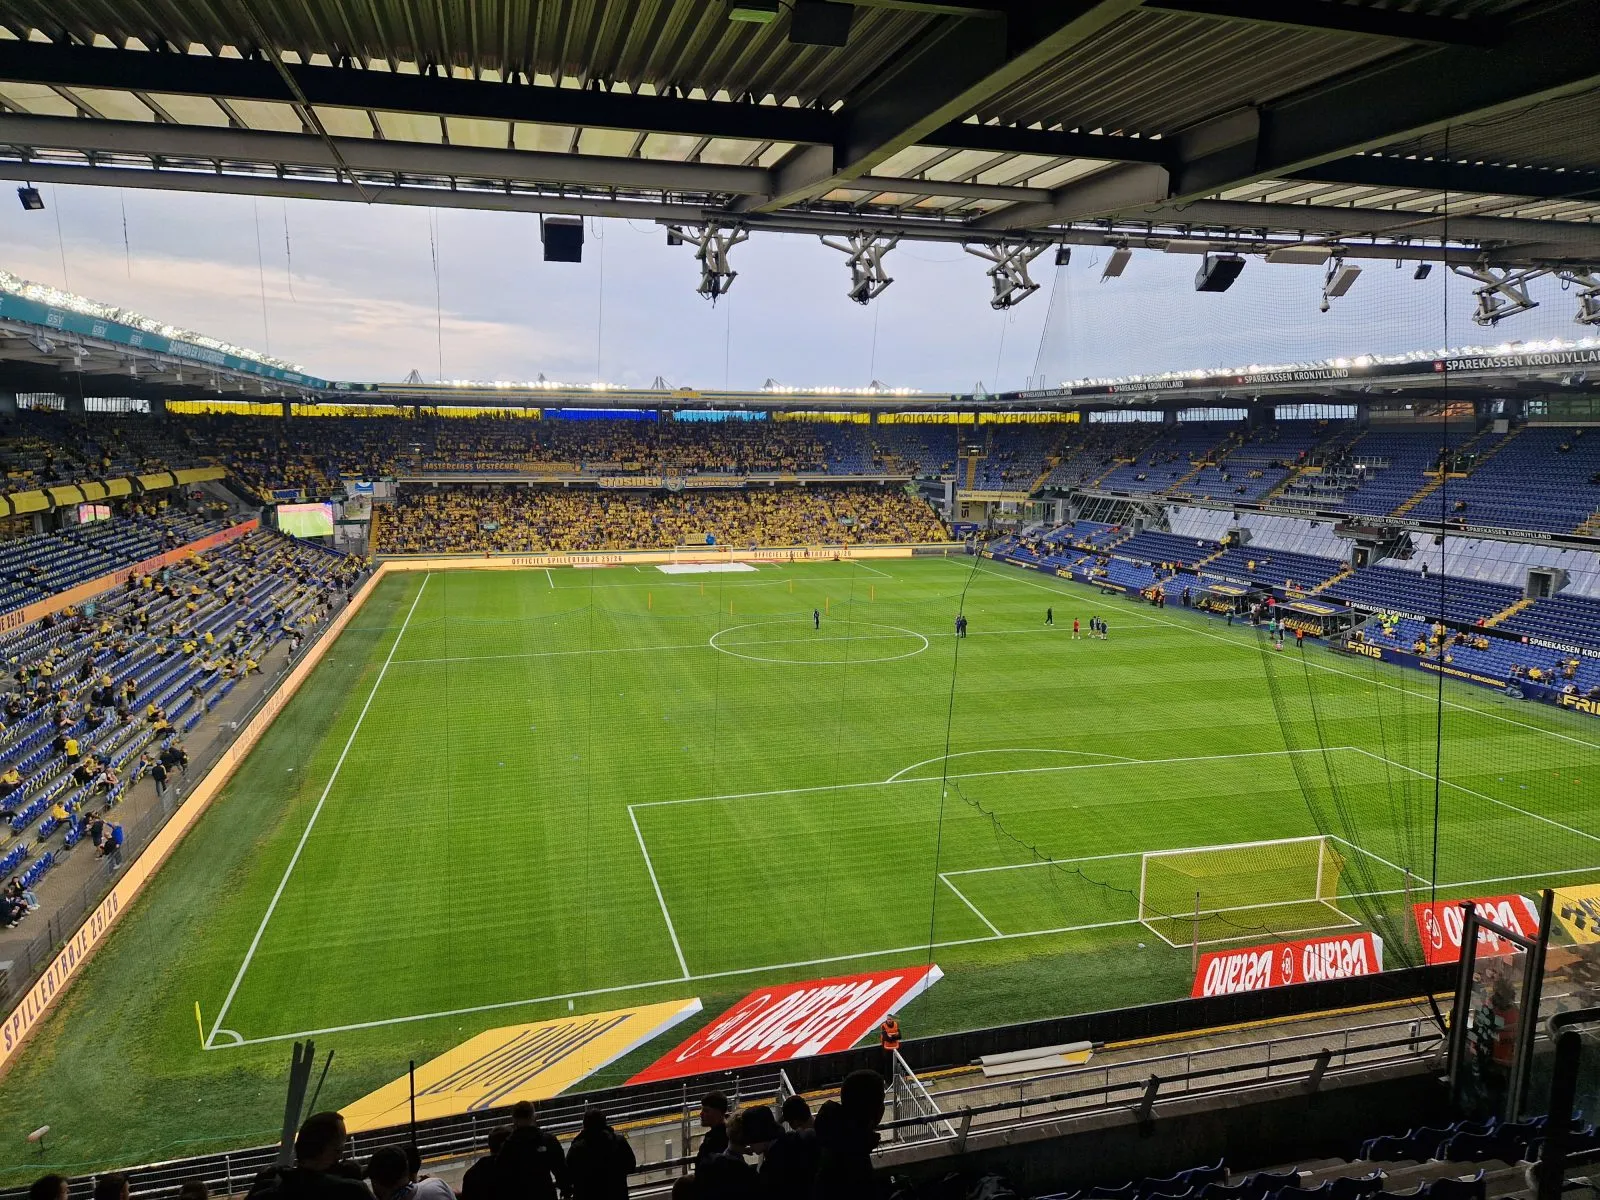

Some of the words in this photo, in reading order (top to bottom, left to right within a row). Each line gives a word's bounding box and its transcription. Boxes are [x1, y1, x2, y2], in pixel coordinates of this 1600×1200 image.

[47, 313, 64, 326] GSV
[92, 325, 108, 335] GSV
[1446, 356, 1523, 371] SPAREKASSEN
[1244, 372, 1292, 384] SPAREKASSEN
[1294, 368, 1349, 381] KRONJYLLAND
[1114, 383, 1147, 393] SPAREKASSEN
[1148, 380, 1184, 390] KRONJYLLAND
[600, 476, 662, 488] SYDSIDEN
[1466, 526, 1507, 536] SPAREKASSEN
[1508, 530, 1552, 540] KRONJYLLAND
[1350, 602, 1386, 614] SPAREKASSEN
[1347, 640, 1382, 659] FRIIS
[1530, 637, 1580, 654] SPAREKASSEN
[4, 930, 88, 1052] SPILLERTRØJE
[92, 891, 118, 938] 25/26
[711, 976, 904, 1062] Betano
